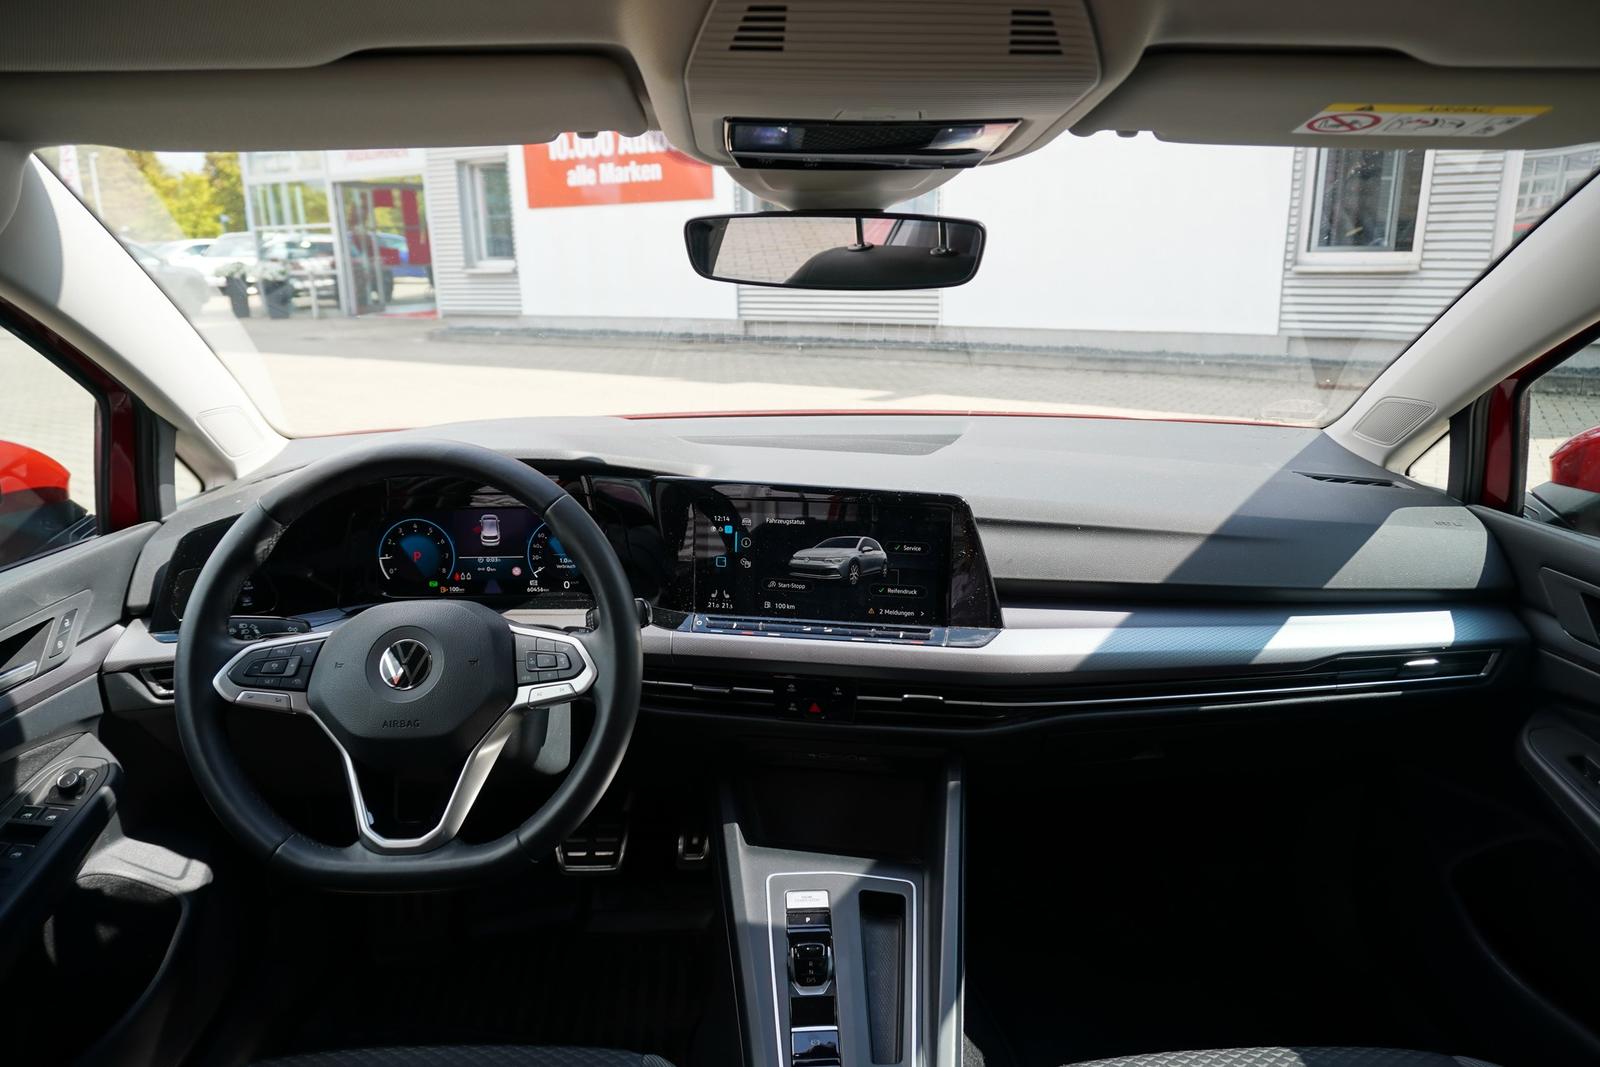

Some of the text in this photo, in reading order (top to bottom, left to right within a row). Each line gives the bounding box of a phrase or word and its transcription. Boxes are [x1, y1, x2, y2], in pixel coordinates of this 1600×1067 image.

[566, 161, 662, 187] alle Marken
[413, 552, 421, 562] P
[382, 720, 420, 728] AIRBAG
